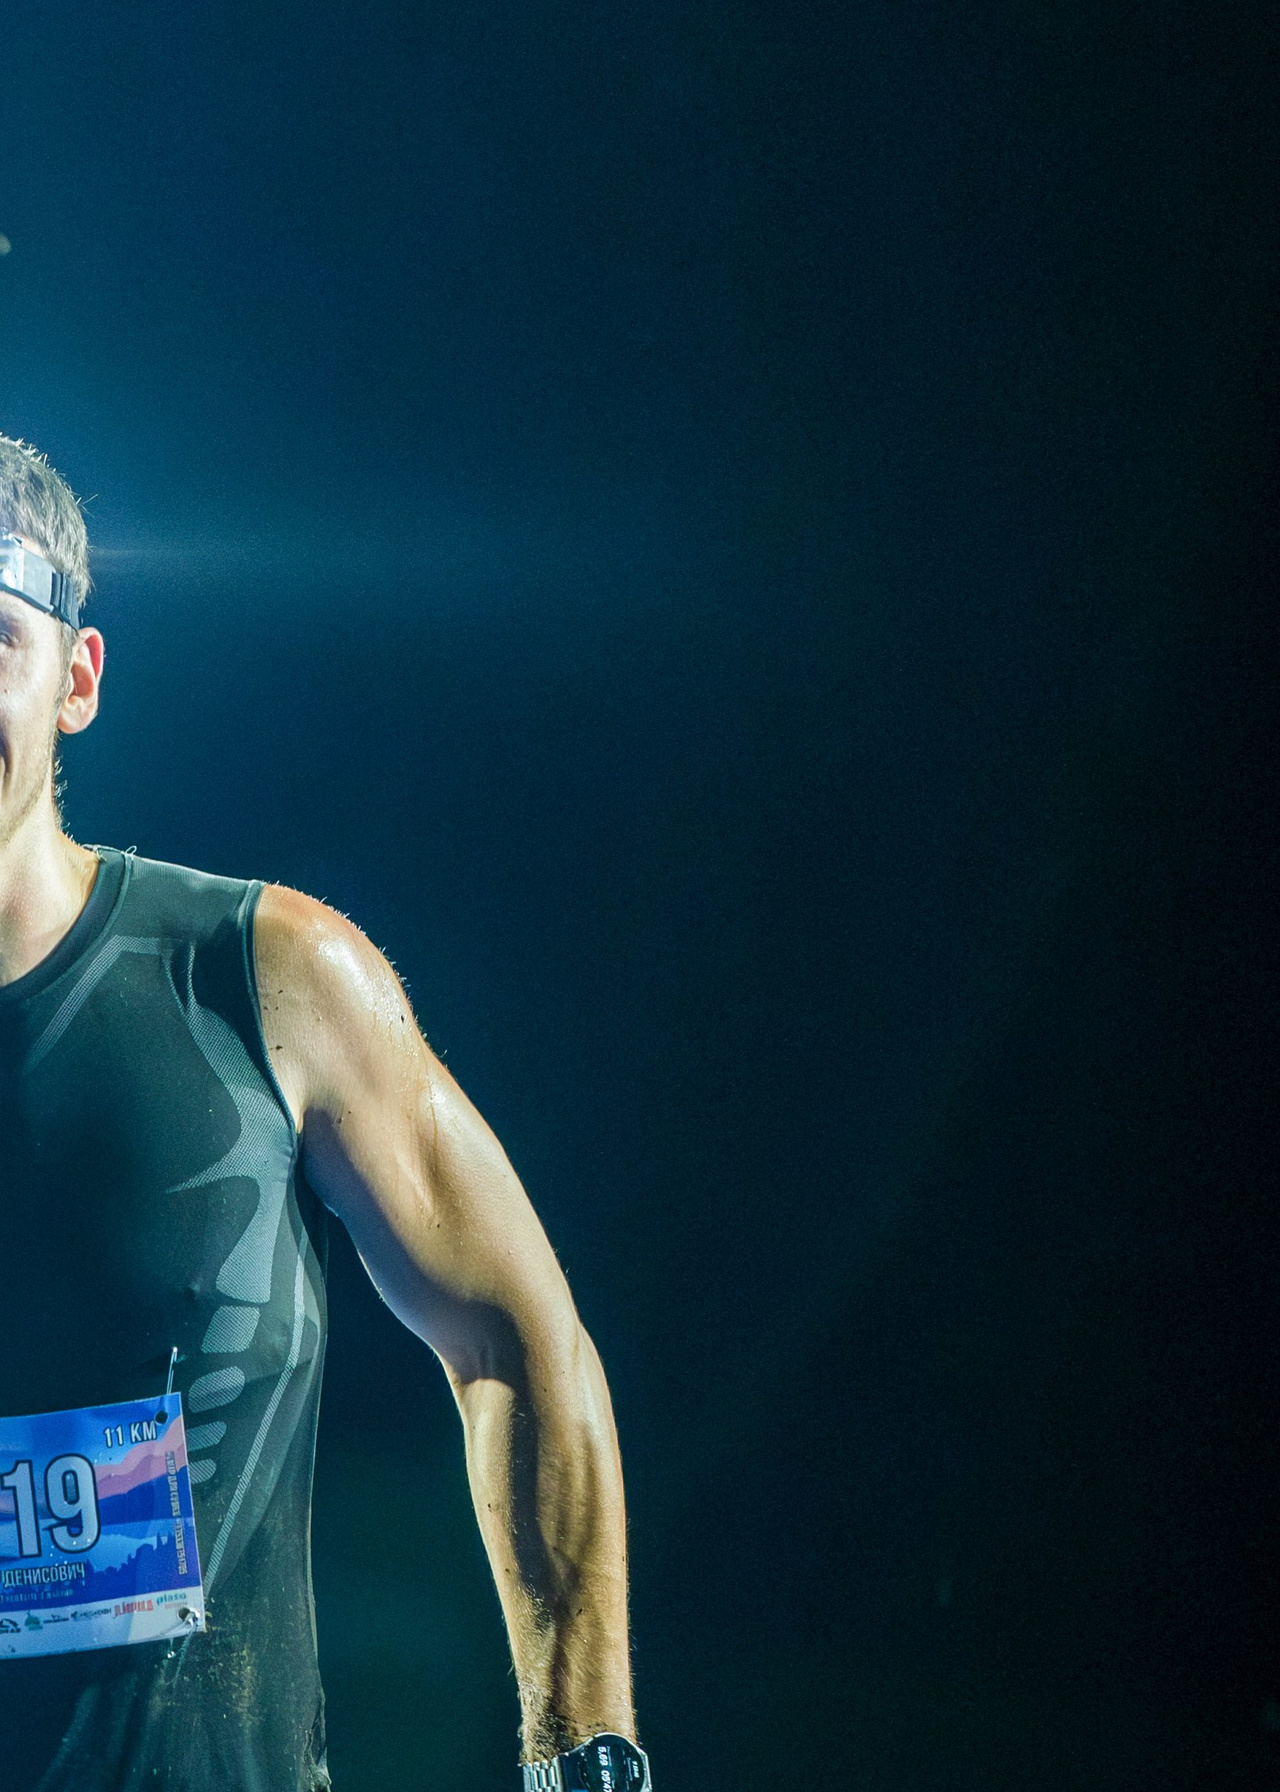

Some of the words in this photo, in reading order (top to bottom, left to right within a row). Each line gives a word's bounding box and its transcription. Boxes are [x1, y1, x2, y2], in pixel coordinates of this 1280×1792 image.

[104, 1425, 124, 1449] 11
[130, 1420, 158, 1444] KM
[4, 1563, 86, 1589] ДЕНИСОВИЧ
